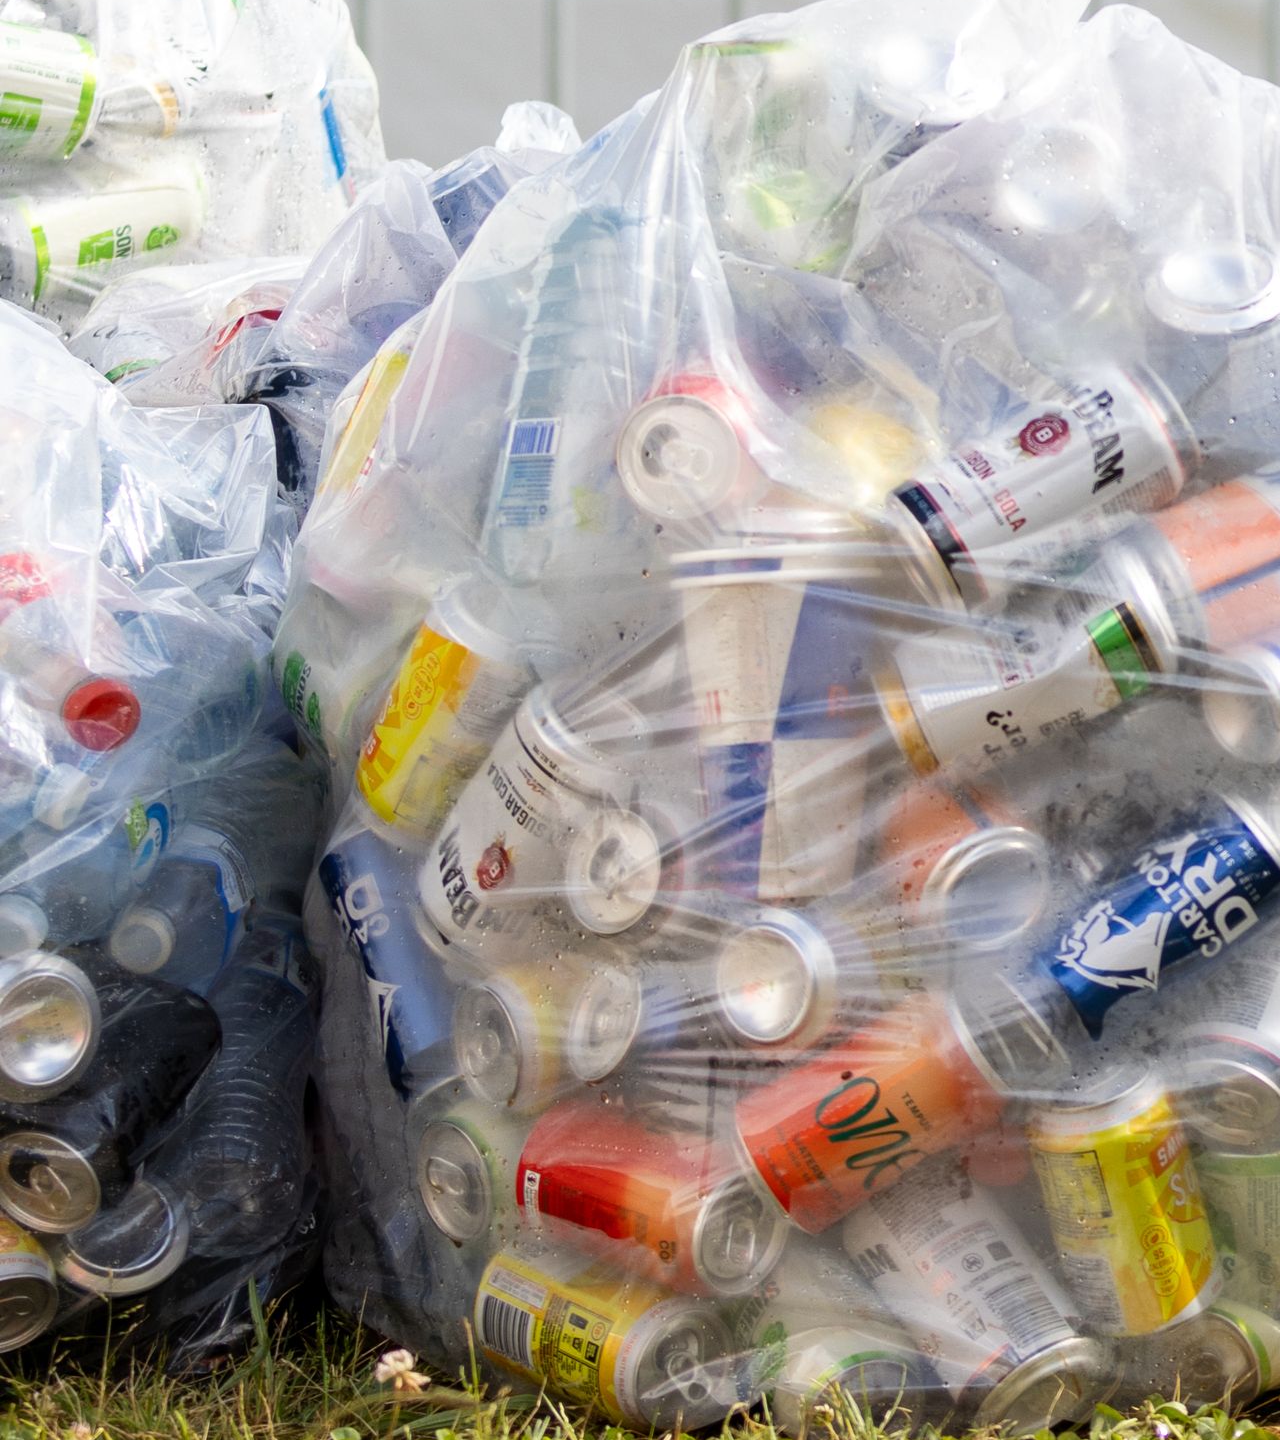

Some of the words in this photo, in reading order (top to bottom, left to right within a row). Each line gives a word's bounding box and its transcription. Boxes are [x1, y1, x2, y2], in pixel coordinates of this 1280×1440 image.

[993, 488, 1027, 532] COLA
[1132, 851, 1224, 958] CARLTON
[1155, 832, 1260, 944] DRY
